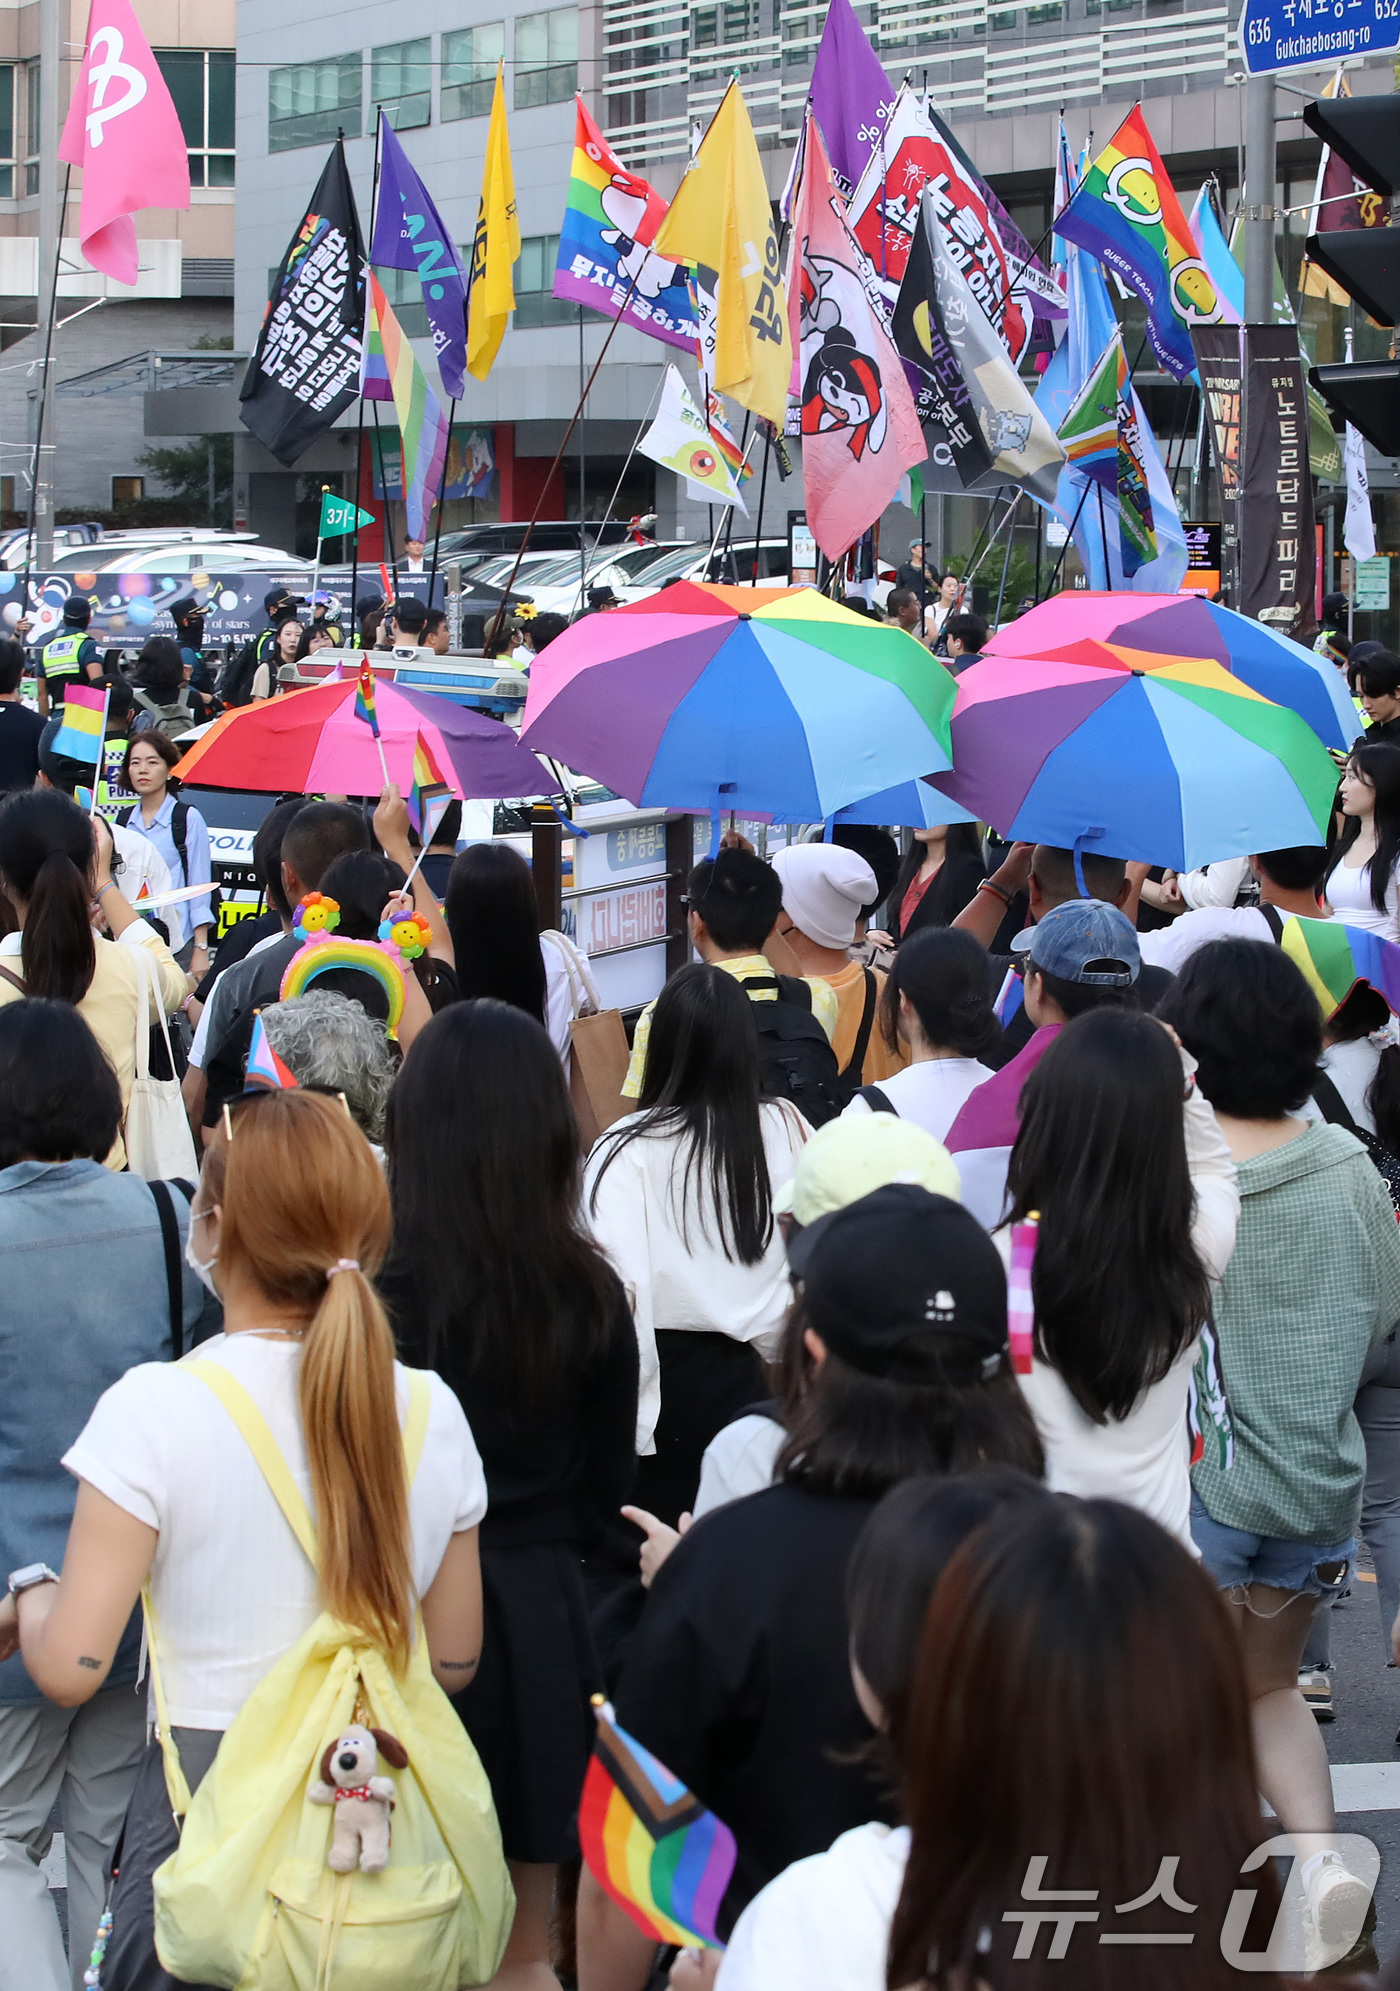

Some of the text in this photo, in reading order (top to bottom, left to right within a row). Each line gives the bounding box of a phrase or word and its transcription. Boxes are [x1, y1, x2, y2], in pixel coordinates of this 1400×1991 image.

[1374, 0, 1399, 20] 632
[1248, 17, 1272, 46] 636
[1275, 25, 1371, 61] Gukchaebosang-ro
[569, 253, 616, 288] 무지
[1103, 248, 1132, 273] QUEER
[1154, 341, 1185, 371] QUEERS
[1271, 377, 1295, 389] 뮤지컬
[225, 619, 250, 629] stars
